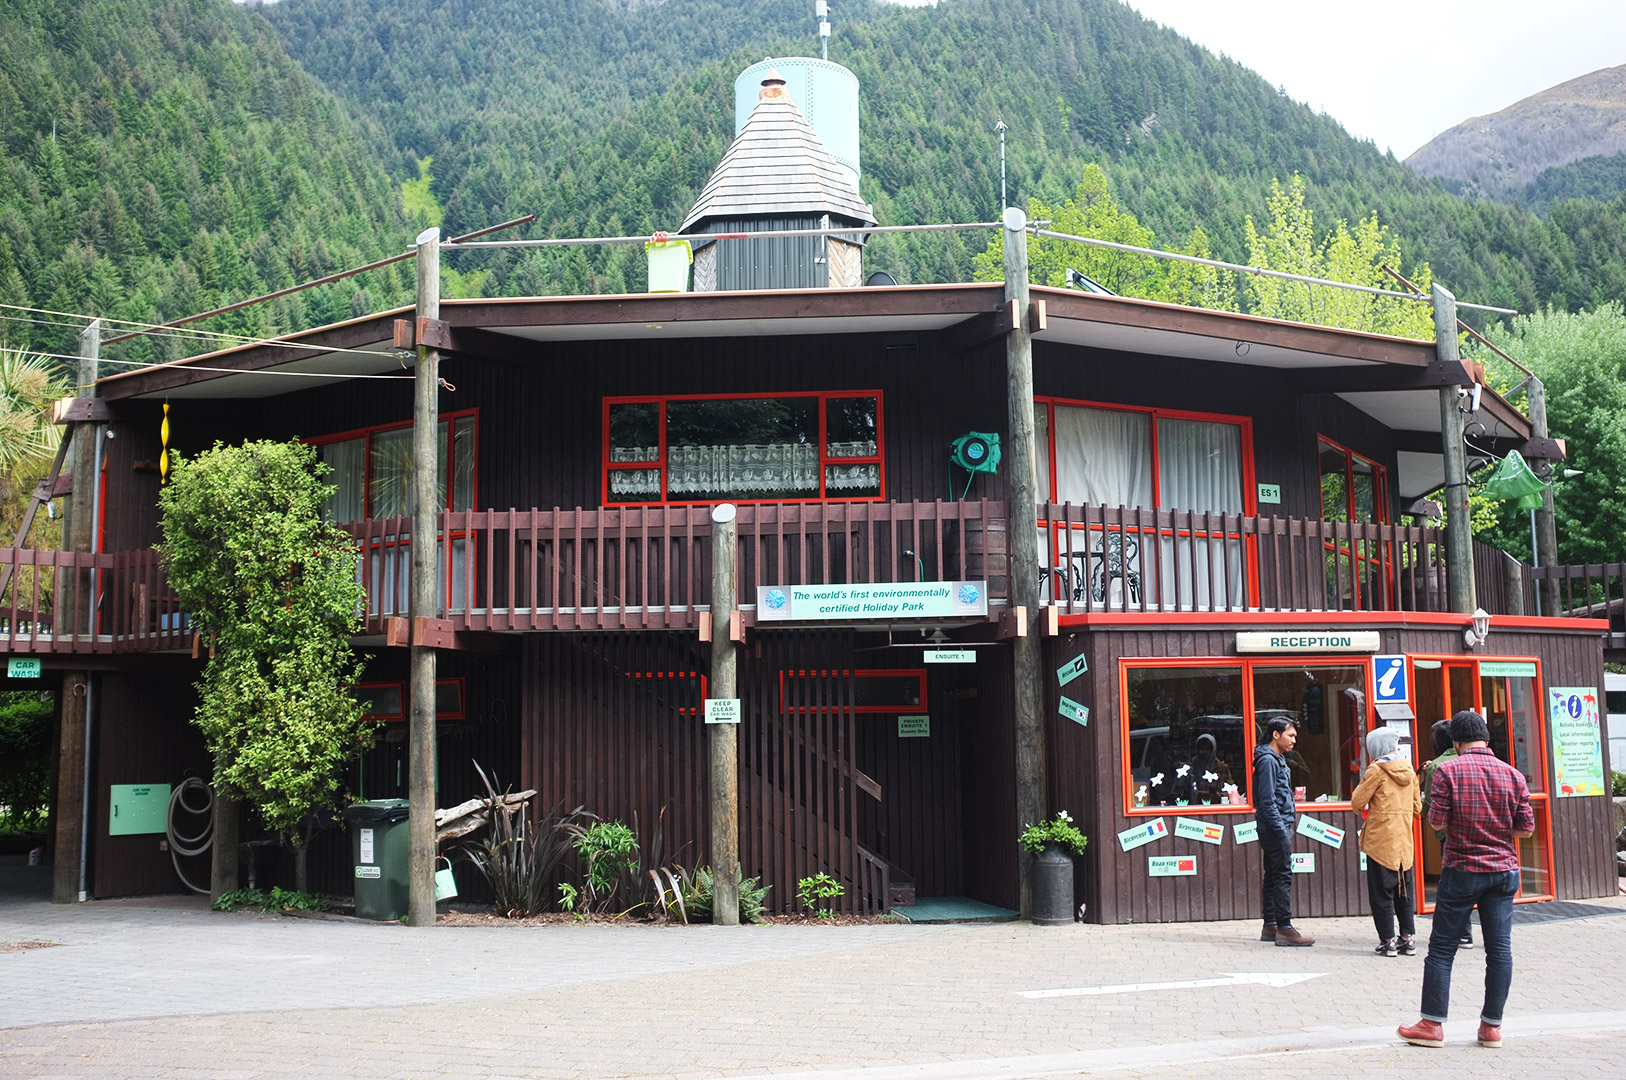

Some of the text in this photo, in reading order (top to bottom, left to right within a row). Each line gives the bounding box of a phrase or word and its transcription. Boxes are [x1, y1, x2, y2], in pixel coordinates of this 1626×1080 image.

[1261, 489, 1278, 497] ES 1
[793, 588, 950, 600] The world's first environmentally
[819, 602, 925, 613] certified Holiday Park
[1270, 637, 1351, 647] RECEPTION
[15, 661, 35, 669] CAR
[11, 670, 40, 678] WASH
[1178, 823, 1204, 833] Bienvenidos
[1306, 823, 1325, 835] Welkom
[1123, 831, 1147, 844] Bienvenue
